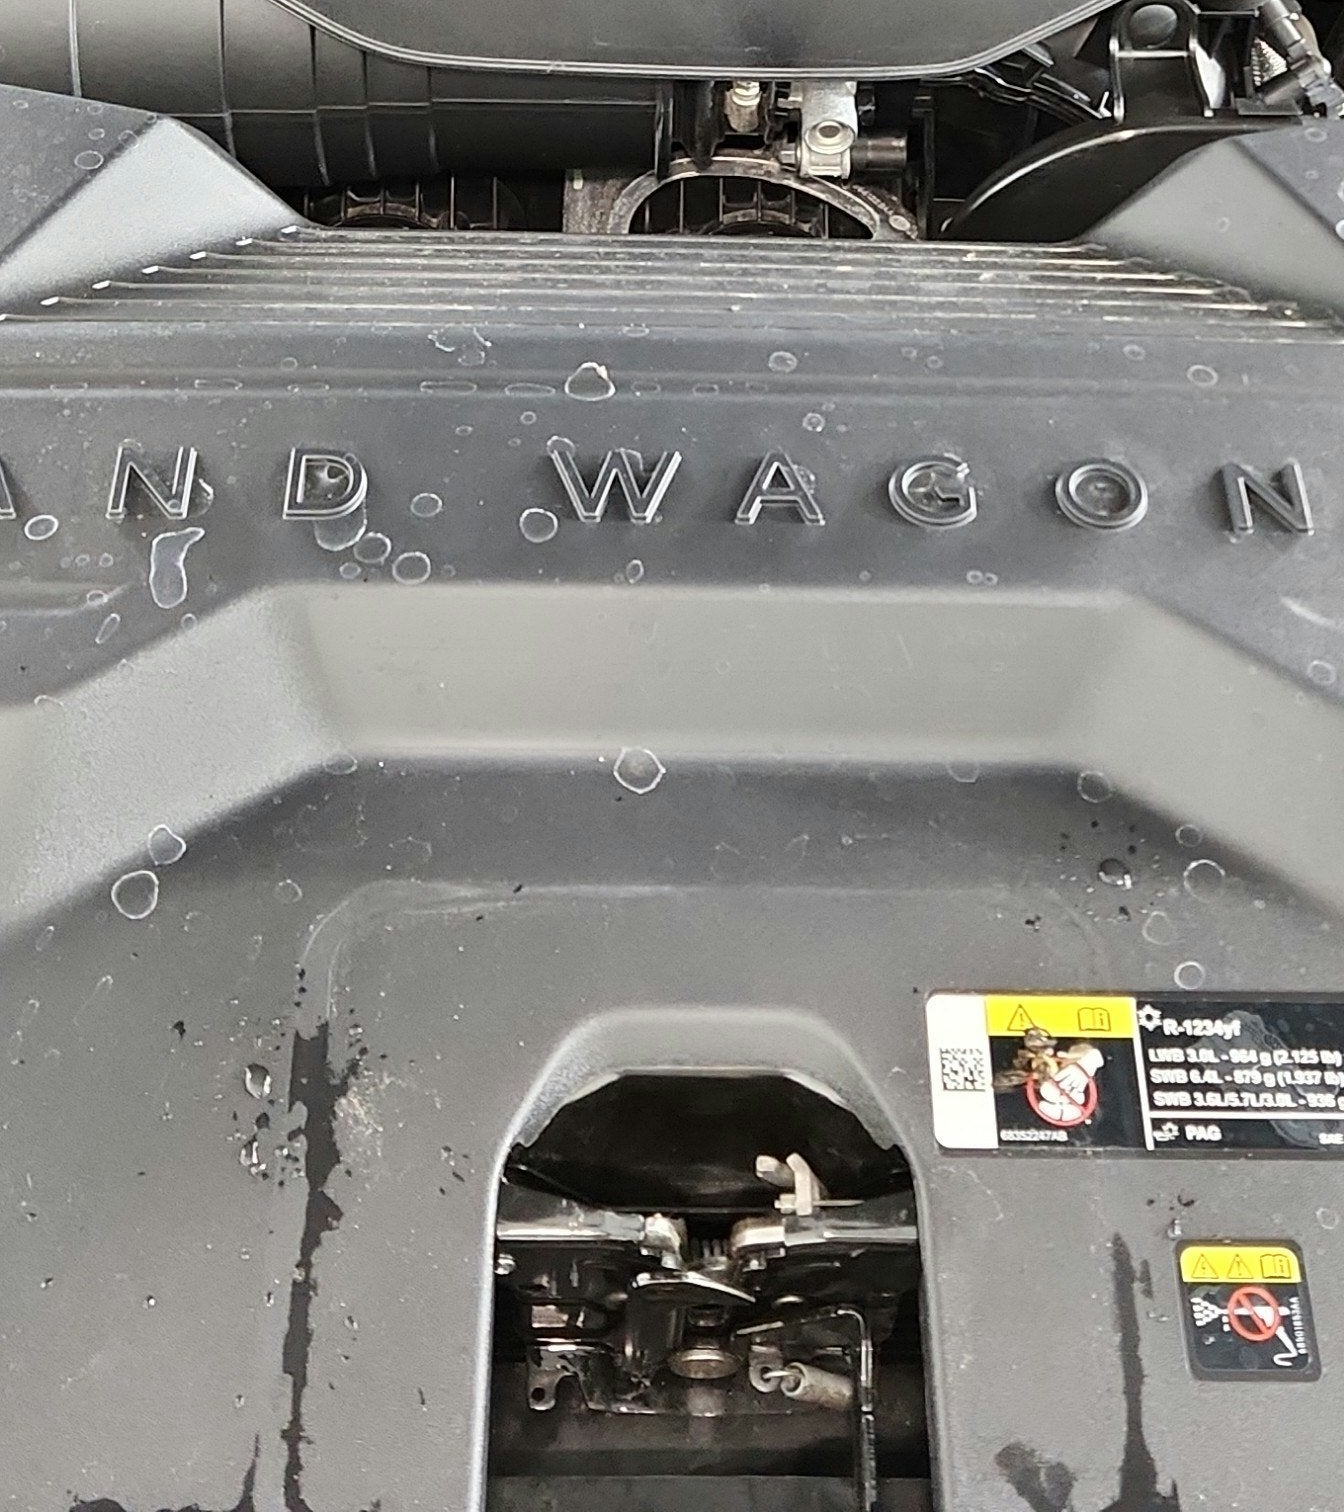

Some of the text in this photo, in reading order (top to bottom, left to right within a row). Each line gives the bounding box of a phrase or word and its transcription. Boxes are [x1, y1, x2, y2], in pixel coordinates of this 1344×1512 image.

[1162, 1018, 1241, 1040] R-1234yf
[1148, 1048, 1185, 1063] LWB
[1259, 1051, 1273, 1067] g
[1149, 1070, 1187, 1085] SWB
[1262, 1073, 1276, 1088] g
[1153, 1091, 1192, 1107] SWB
[1185, 1125, 1223, 1141] PAG
